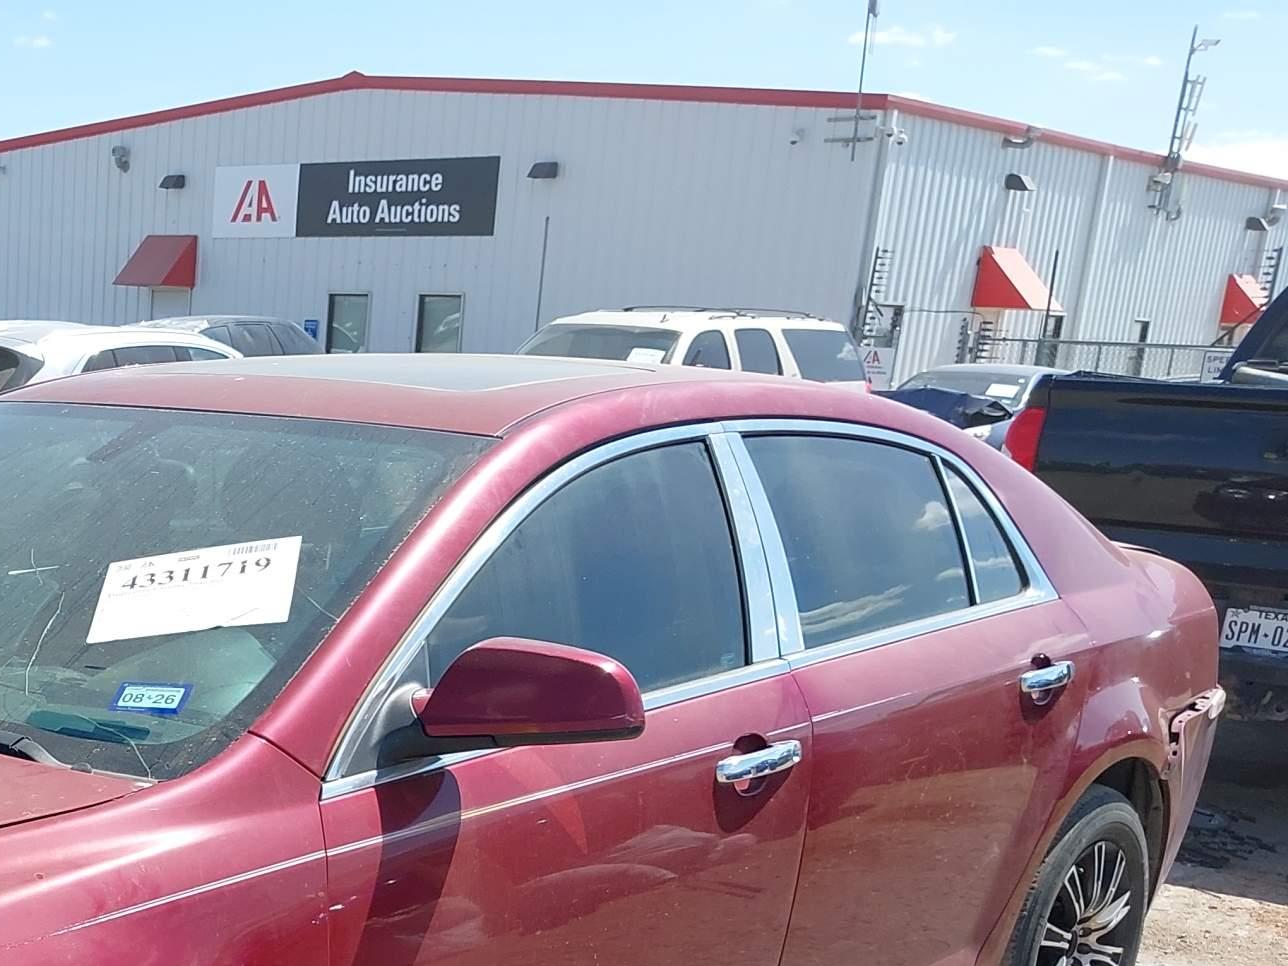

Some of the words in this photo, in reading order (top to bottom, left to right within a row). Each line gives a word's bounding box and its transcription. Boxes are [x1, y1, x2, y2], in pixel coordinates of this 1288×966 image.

[347, 169, 444, 193] Insurance
[326, 200, 371, 225] Auto
[374, 197, 460, 224] Auctions
[122, 557, 272, 589] 43311719
